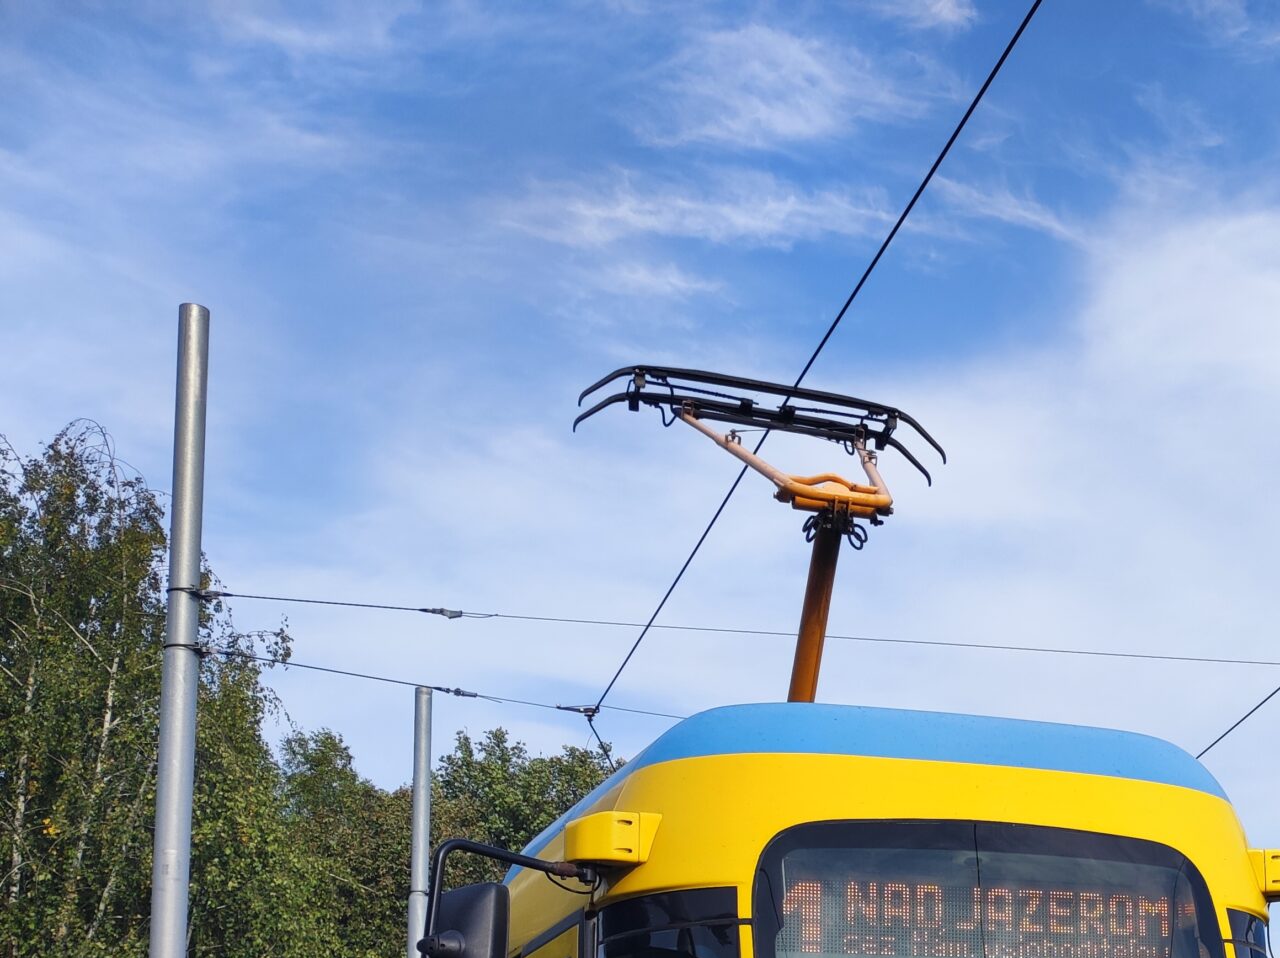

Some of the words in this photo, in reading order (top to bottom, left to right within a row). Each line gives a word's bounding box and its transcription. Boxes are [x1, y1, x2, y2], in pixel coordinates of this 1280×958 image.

[783, 882, 821, 953] 1
[847, 881, 943, 928] NAD
[957, 887, 1169, 938] JAZEROM
